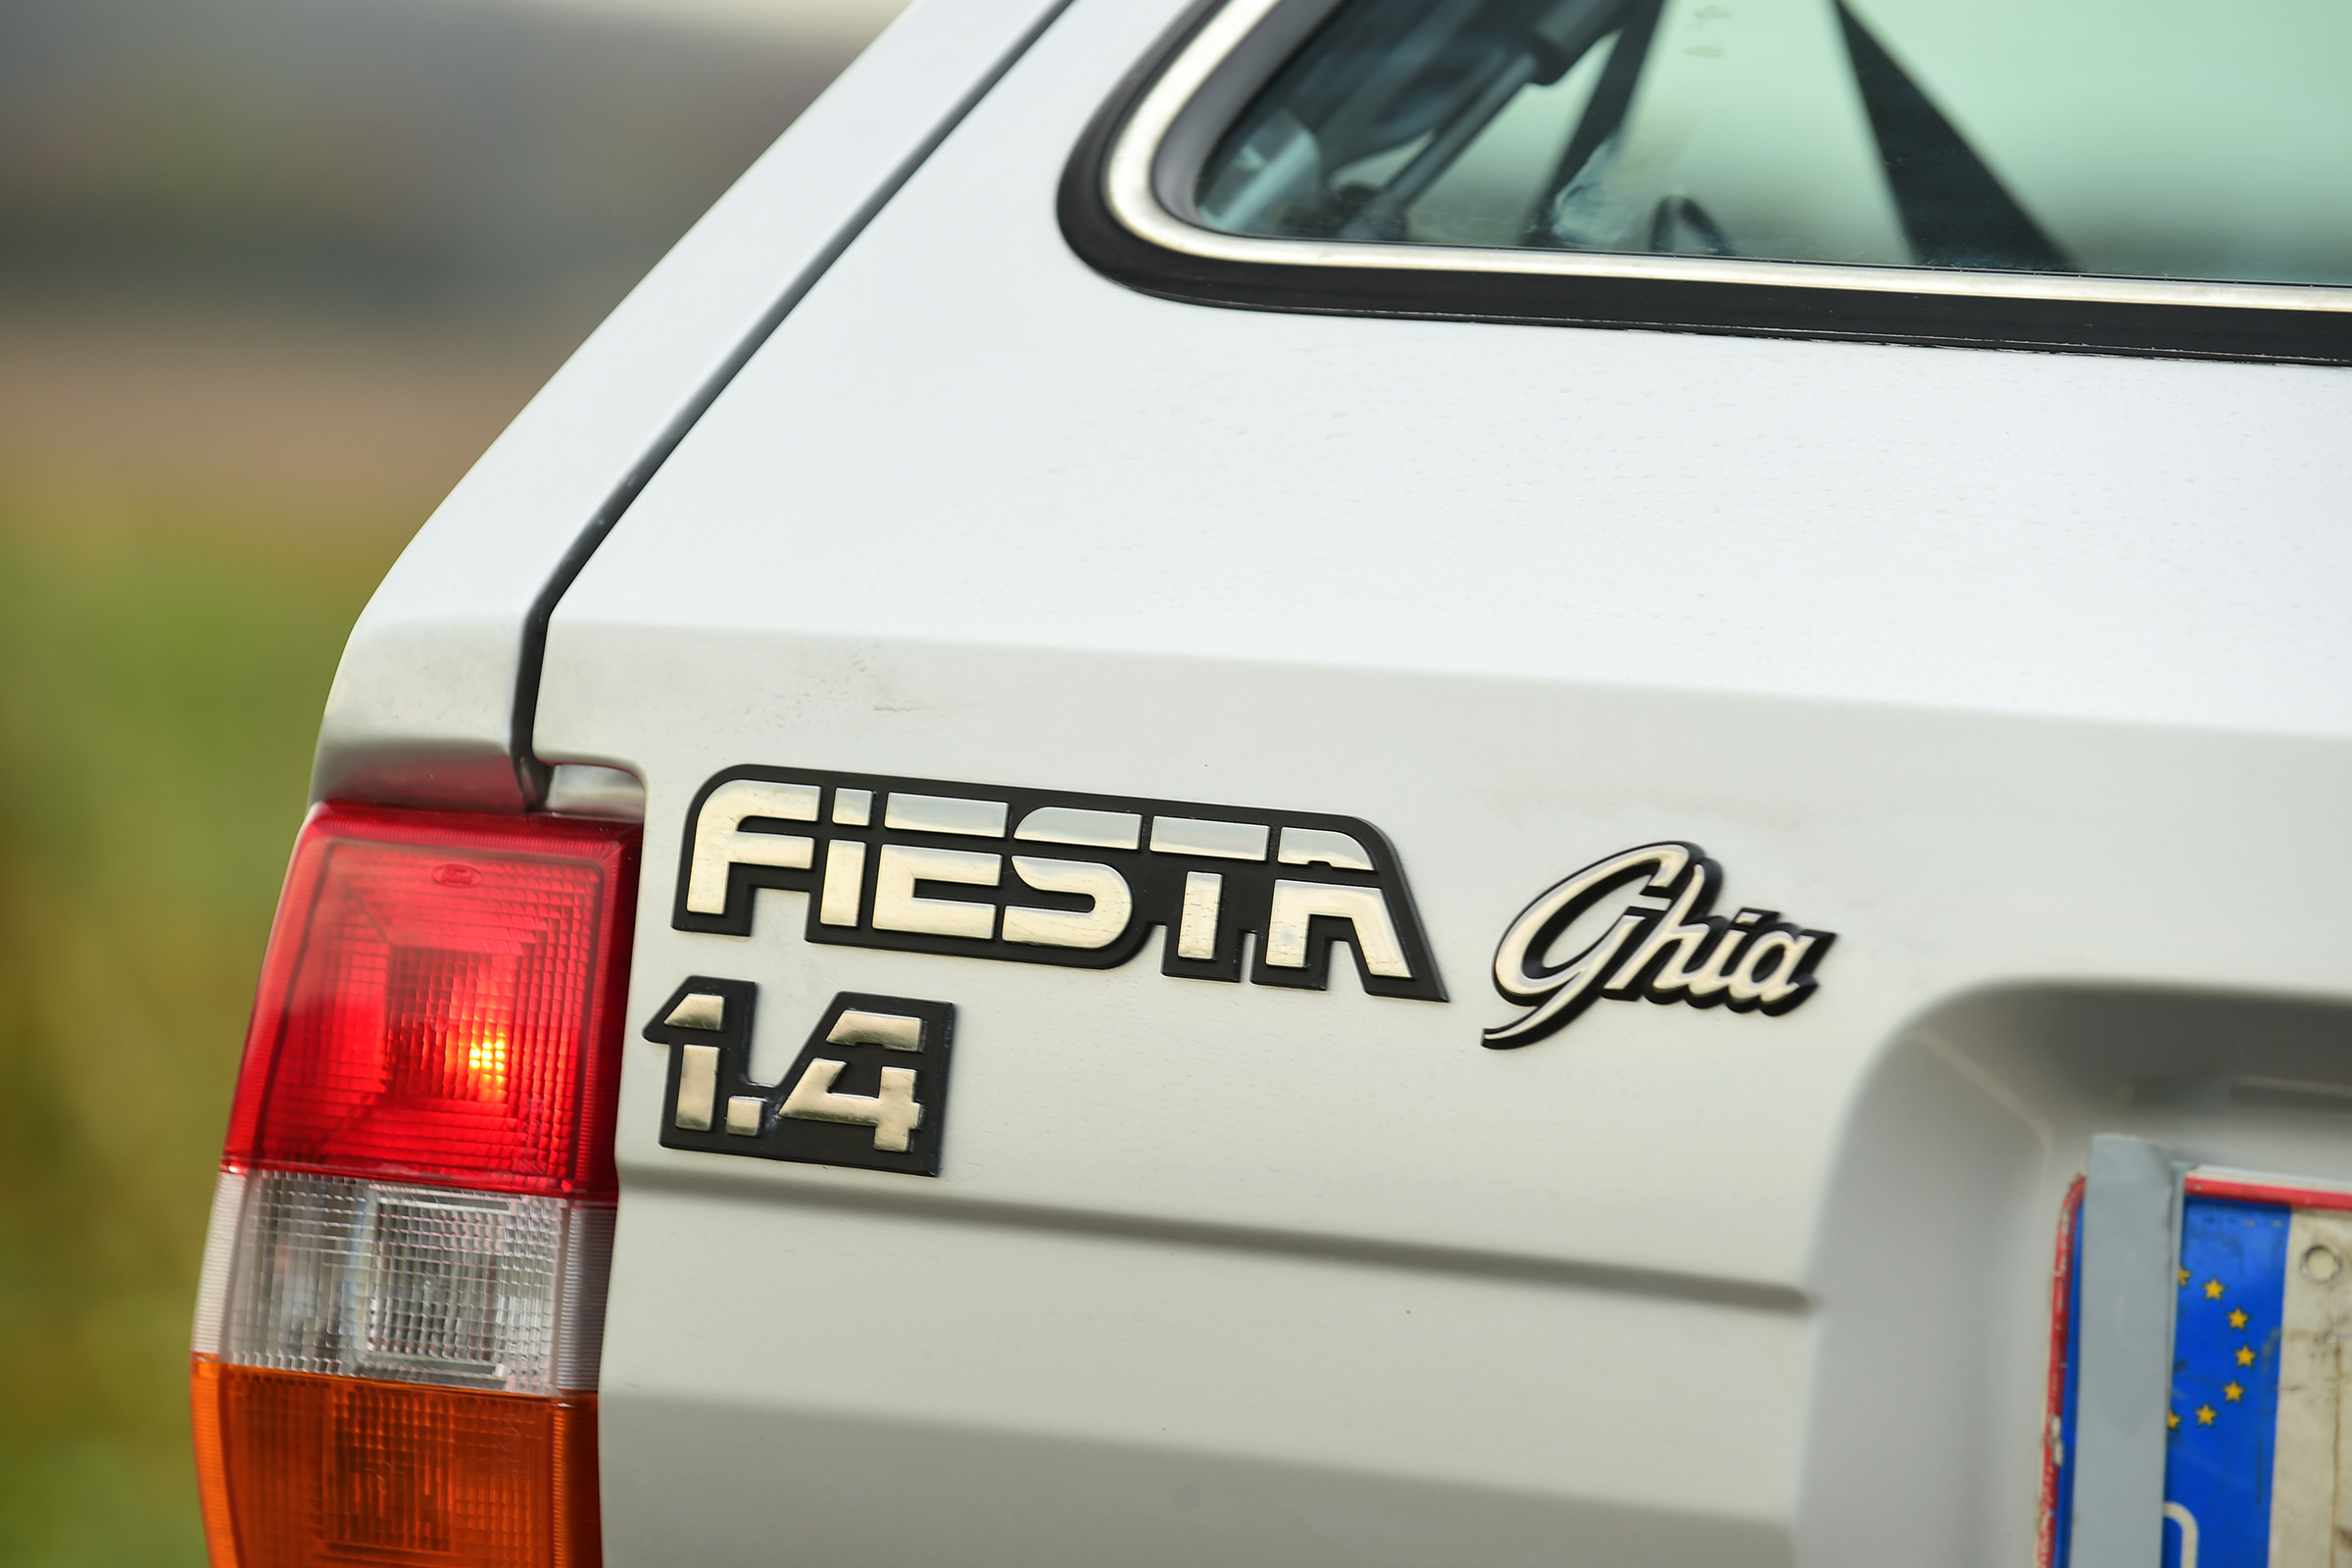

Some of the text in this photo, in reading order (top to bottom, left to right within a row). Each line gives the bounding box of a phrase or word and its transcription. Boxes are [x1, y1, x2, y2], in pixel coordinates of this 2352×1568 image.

[684, 778, 1416, 979] FIESTA
[1483, 843, 1825, 1044] Ghia
[662, 991, 925, 1153] 1.4
